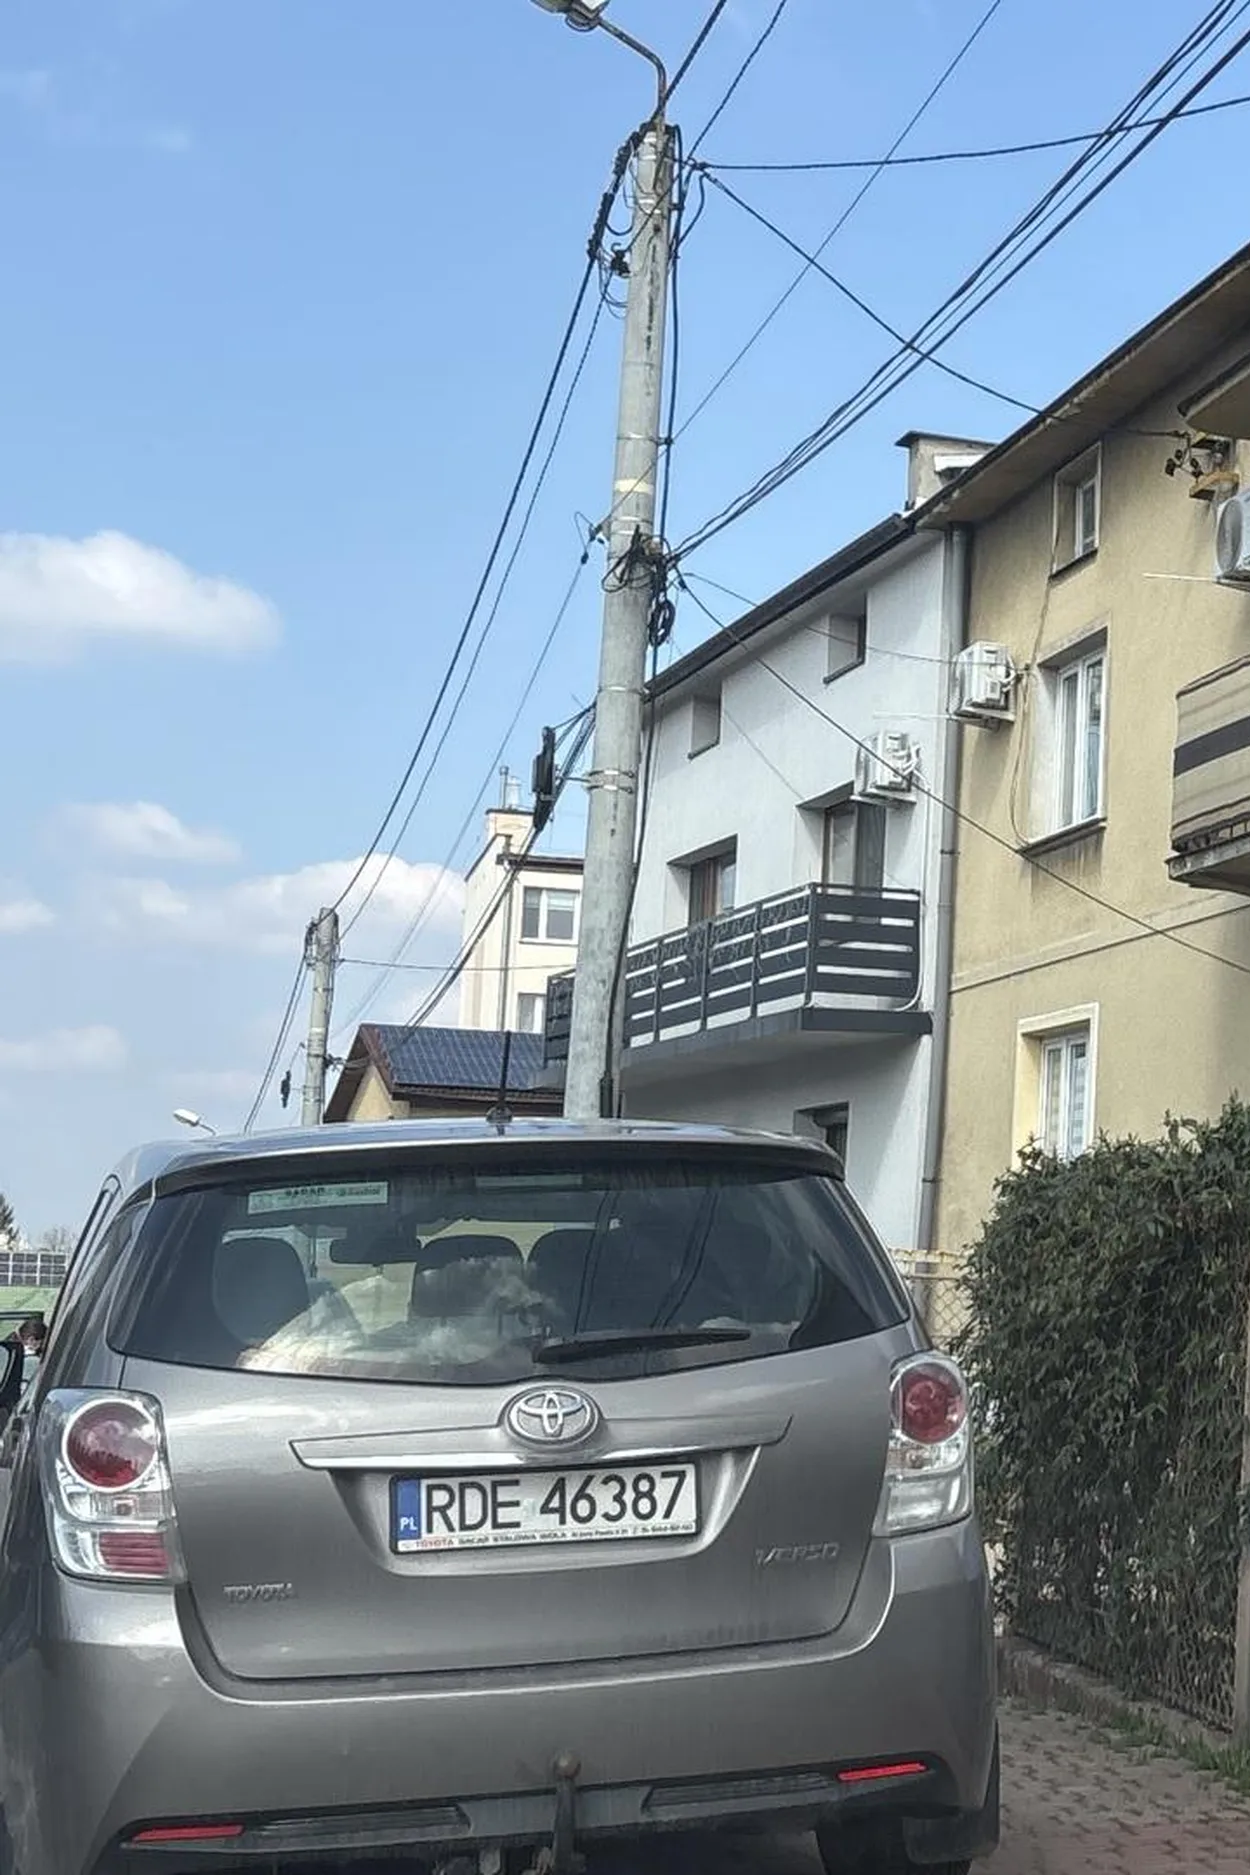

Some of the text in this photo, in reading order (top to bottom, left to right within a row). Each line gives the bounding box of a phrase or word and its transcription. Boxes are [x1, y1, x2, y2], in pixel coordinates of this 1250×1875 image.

[426, 1470, 686, 1533] RDE 46387
[400, 1516, 418, 1531] PL
[755, 1542, 839, 1565] VERSO
